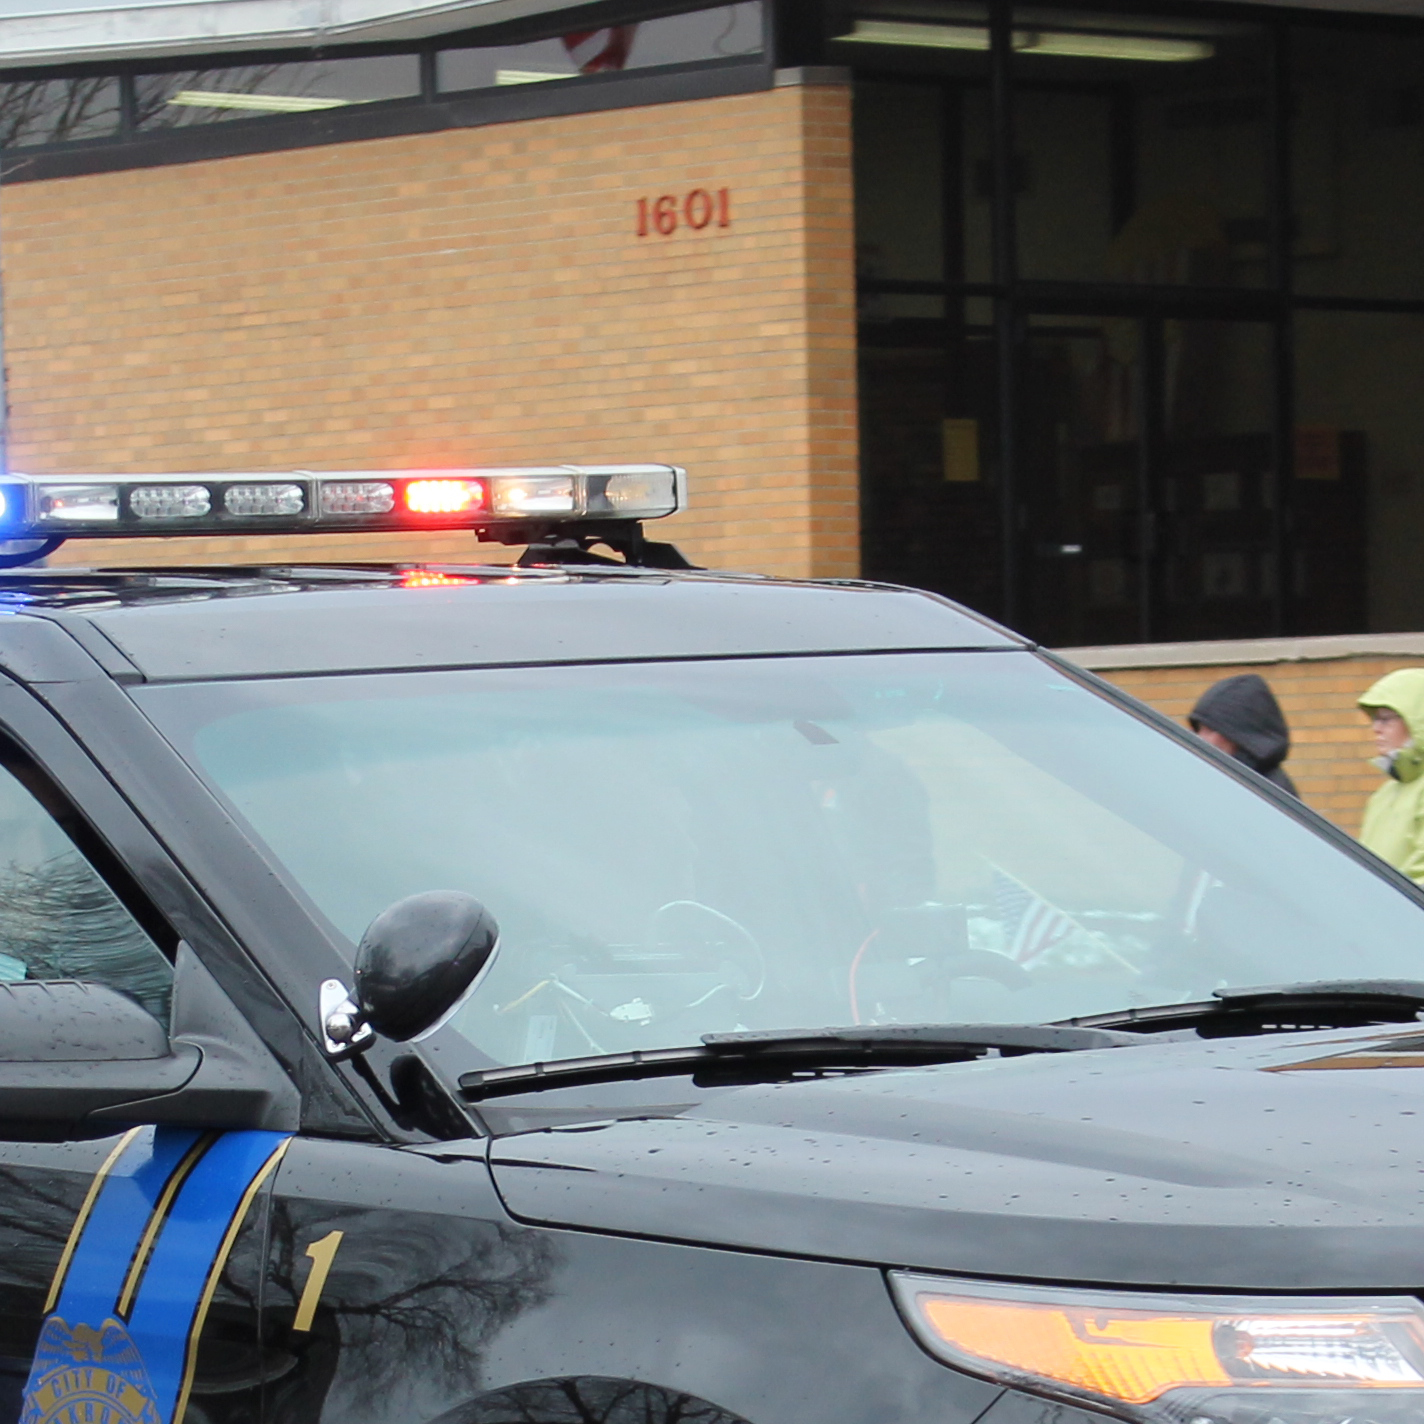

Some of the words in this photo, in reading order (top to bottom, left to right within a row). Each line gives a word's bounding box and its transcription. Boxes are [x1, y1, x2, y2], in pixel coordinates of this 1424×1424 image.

[637, 186, 730, 237] 1601
[292, 1230, 344, 1332] 1
[51, 1368, 93, 1398] CITY
[106, 1373, 127, 1398] OF
